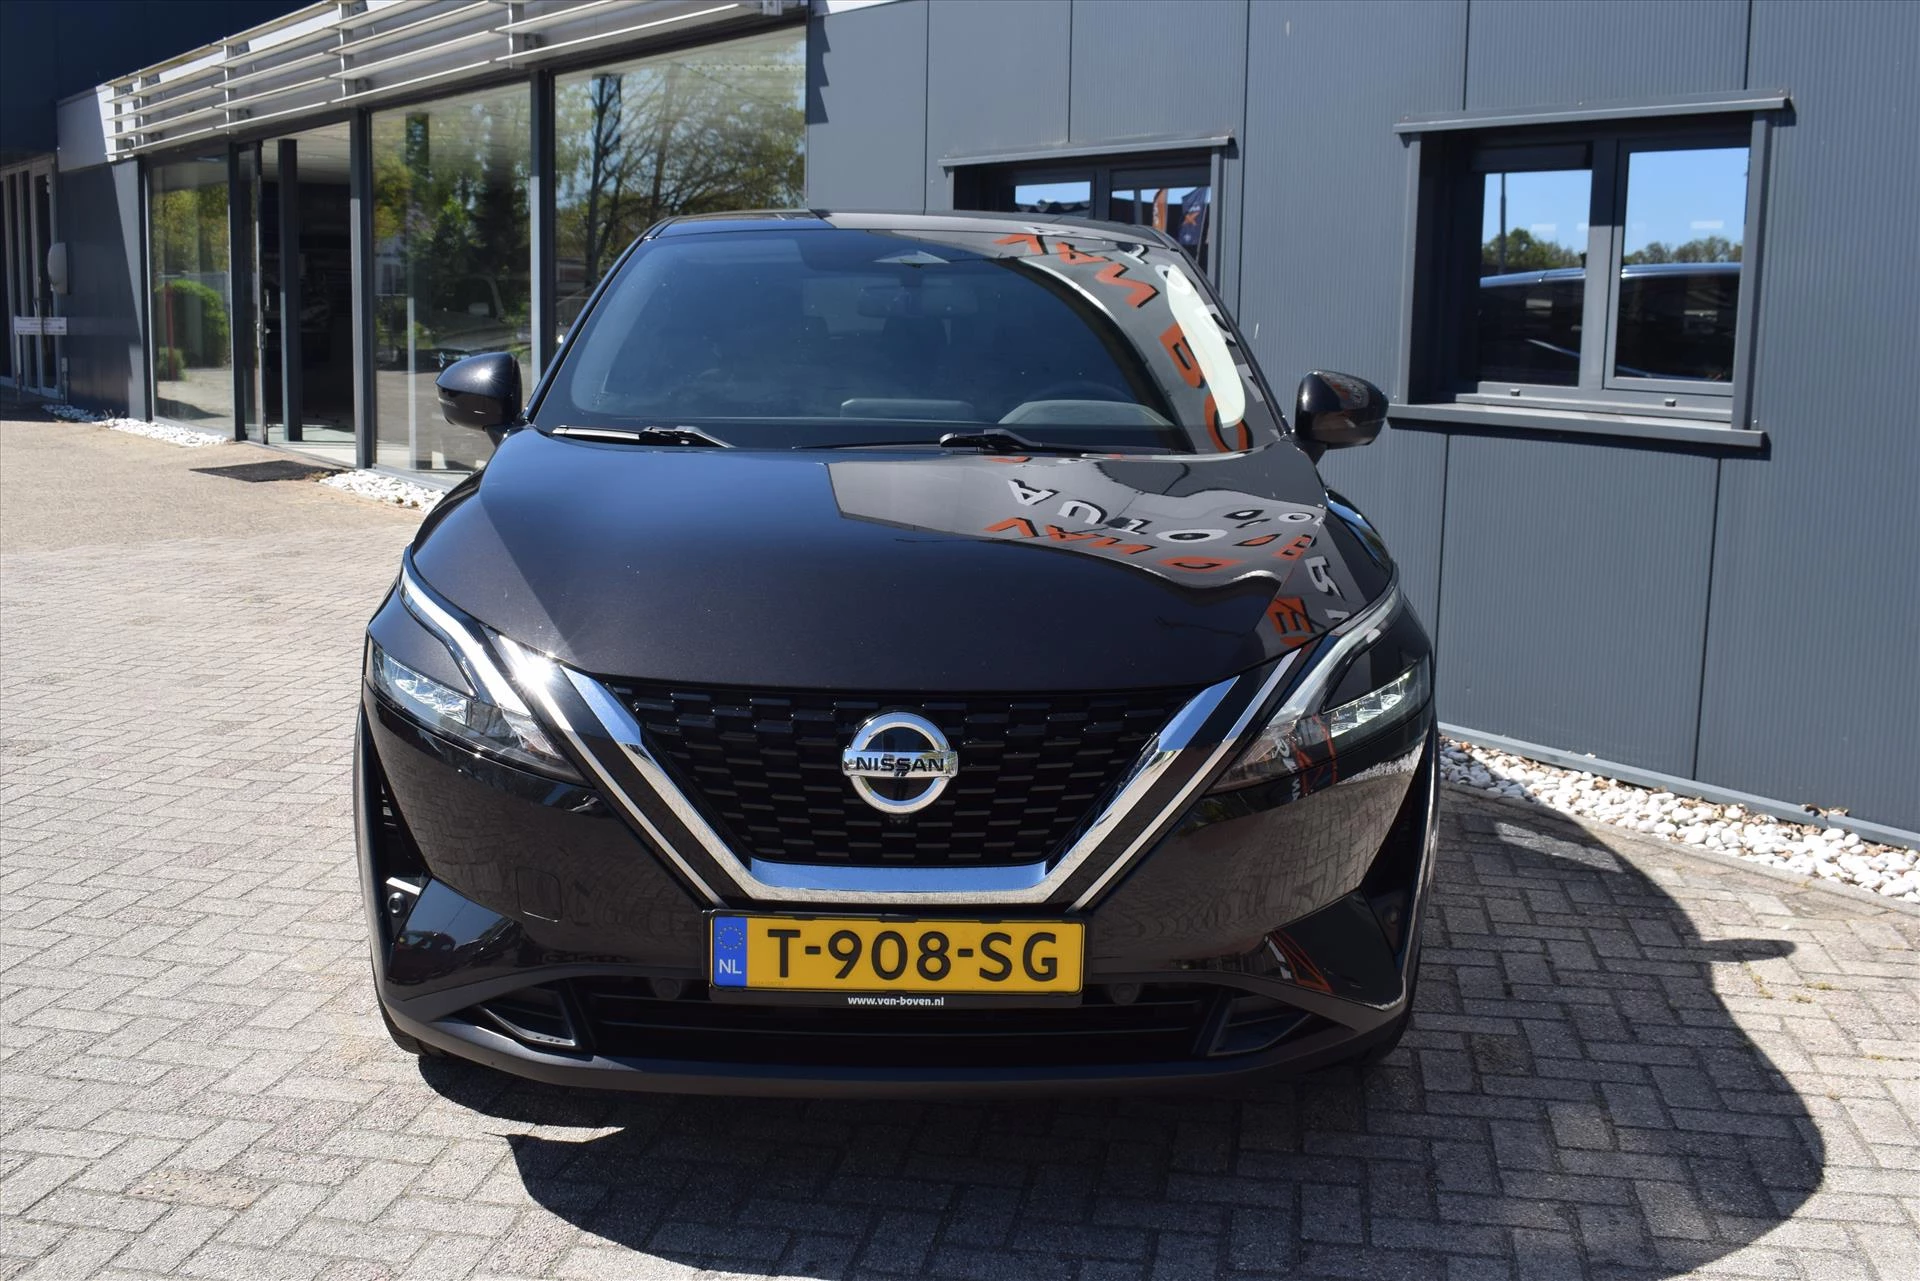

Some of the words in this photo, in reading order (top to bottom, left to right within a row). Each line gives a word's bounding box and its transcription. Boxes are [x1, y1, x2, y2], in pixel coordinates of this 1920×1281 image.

[855, 756, 944, 772] NISSAN
[767, 928, 1058, 982] T-908-SG
[719, 958, 742, 974] NL
[847, 996, 945, 1006] www.van-boven.nl
